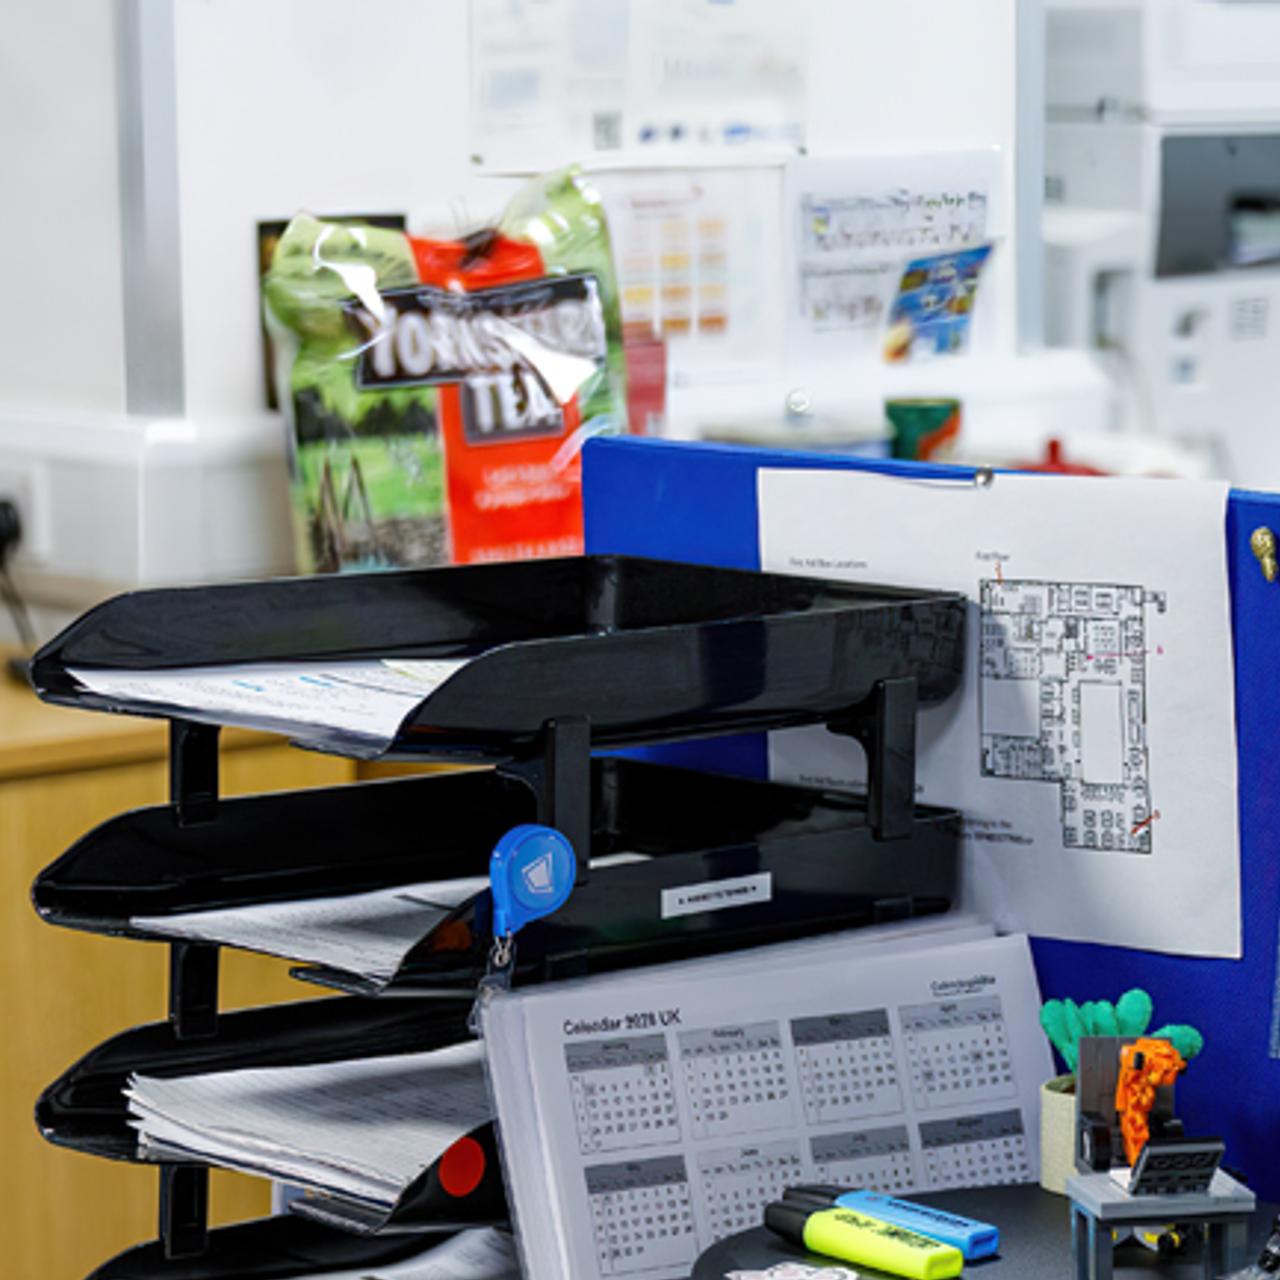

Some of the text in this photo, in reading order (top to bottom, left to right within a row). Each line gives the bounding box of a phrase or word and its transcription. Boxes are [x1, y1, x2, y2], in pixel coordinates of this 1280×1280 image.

[469, 371, 562, 434] TEA
[562, 1016, 622, 1036] Calendar
[658, 1008, 682, 1026] UK
